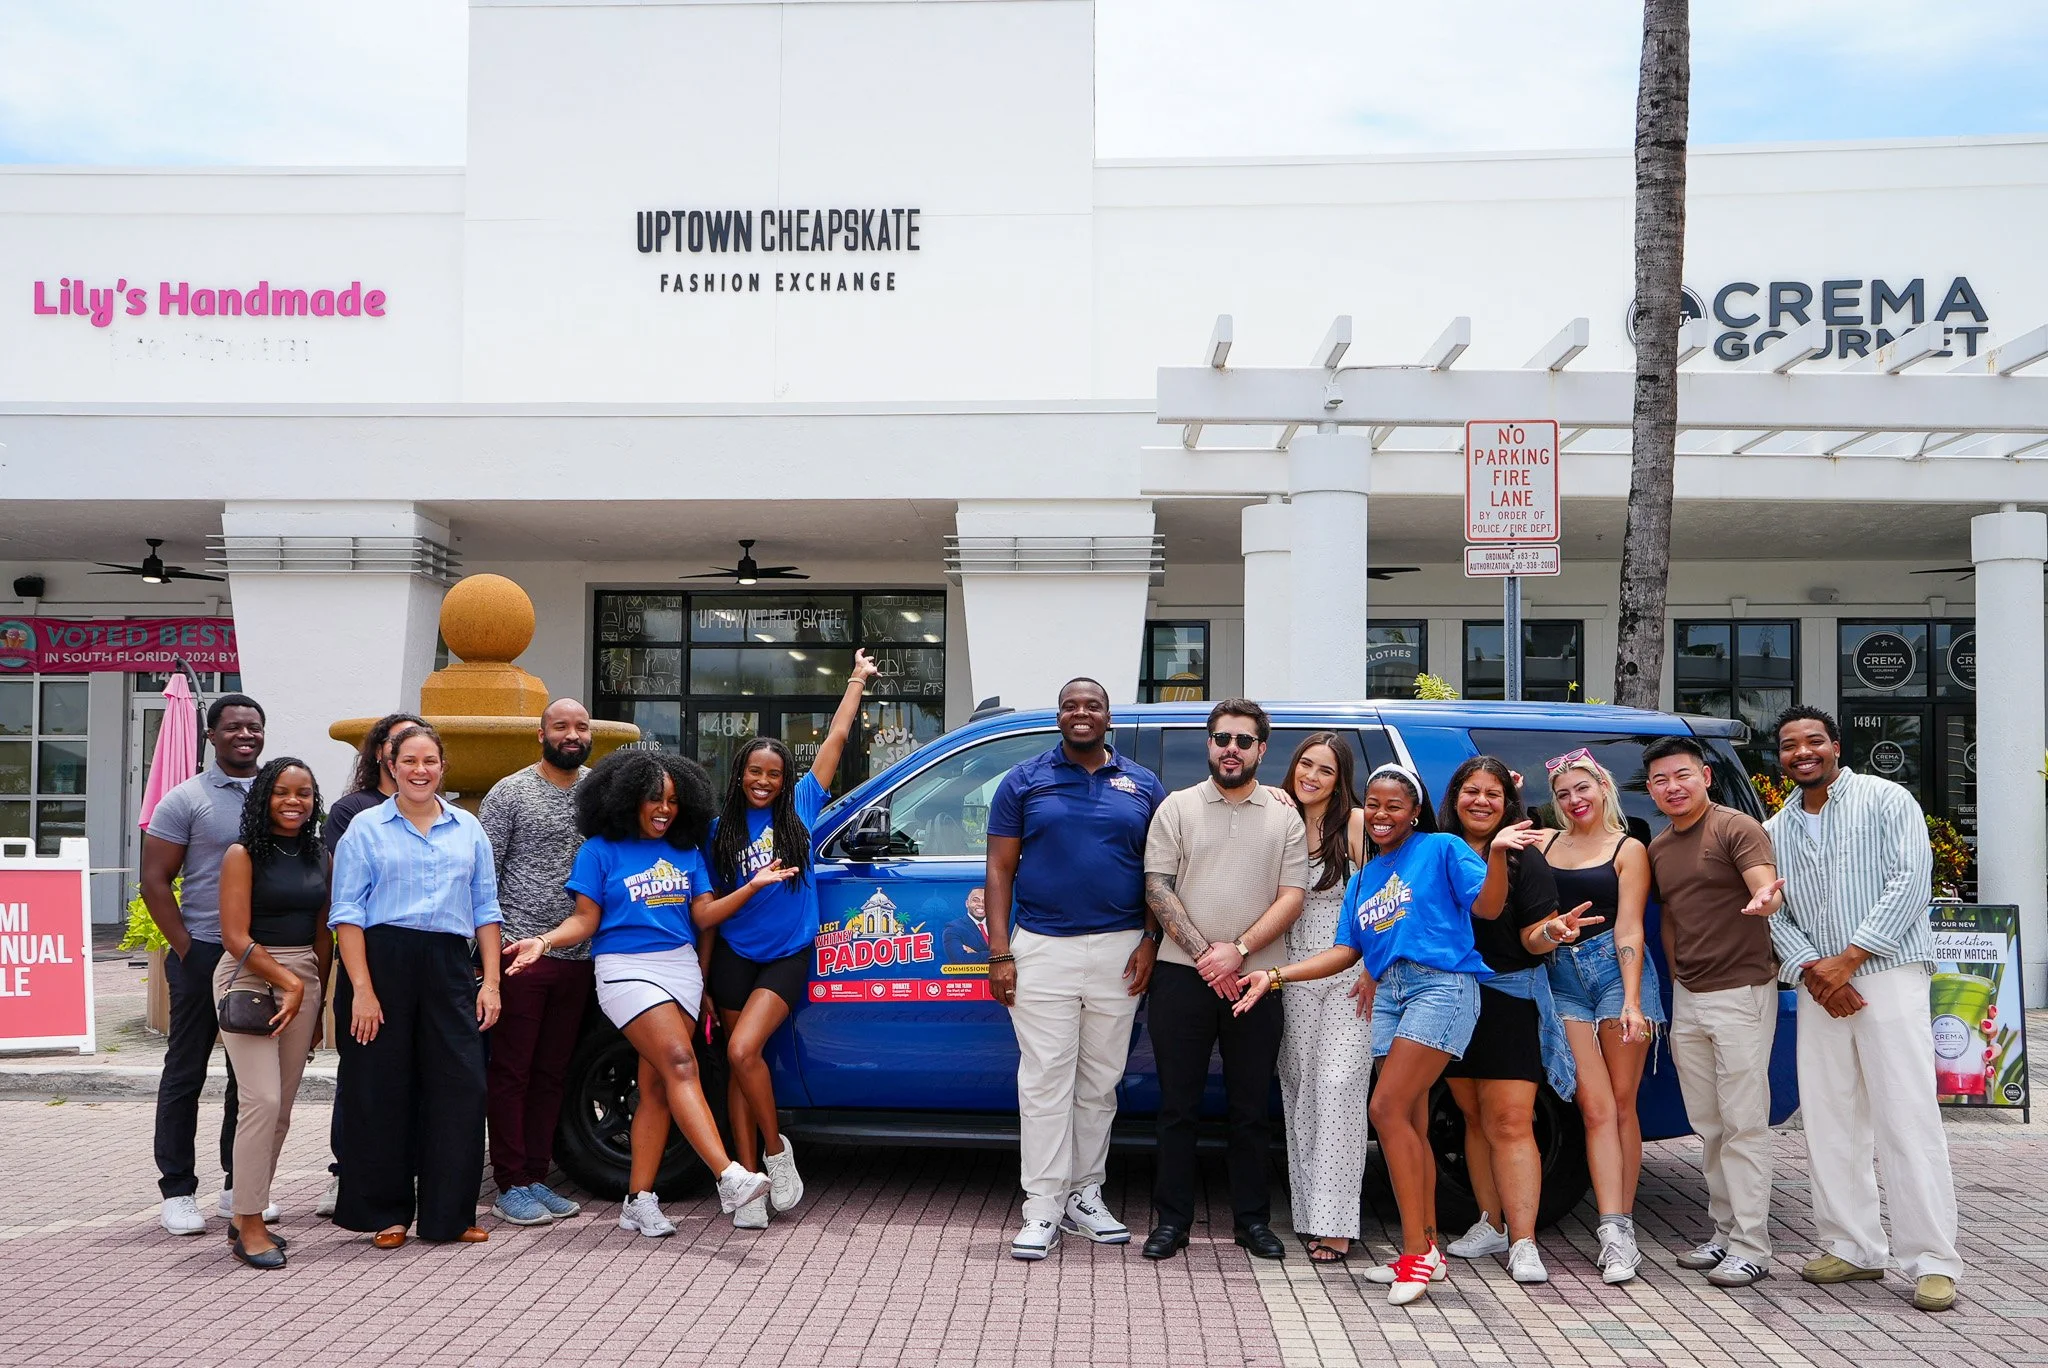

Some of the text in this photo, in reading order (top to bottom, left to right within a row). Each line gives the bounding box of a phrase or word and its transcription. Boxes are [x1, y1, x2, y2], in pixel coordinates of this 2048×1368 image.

[637, 208, 921, 253] UPTOWN CHEAPSKATE
[660, 272, 896, 292] FASHION EXCHANGE
[34, 278, 387, 327] Lily's Handmade
[1713, 277, 1989, 328] CREMA
[1498, 428, 1525, 445] NO
[1474, 449, 1550, 465] PARKING
[1493, 470, 1531, 486] FIRE
[1491, 491, 1534, 507] LANE
[1479, 511, 1545, 520] BY ORDER OF
[1472, 525, 1500, 533] POLICE
[1510, 524, 1527, 533] FIRE
[1530, 524, 1553, 533] DEPT.
[1485, 552, 1515, 561] ORDINANCE
[1470, 562, 1510, 571] AUTHORIZATION
[700, 608, 842, 629] UPTOWN CHEAPSKATE
[46, 625, 236, 648] VOTED BEST
[45, 652, 237, 664] IN SOUTH FLORIDA 2024 BY
[1863, 656, 1906, 665] CREMA
[1853, 716, 1881, 728] 14841
[637, 741, 647, 751] TO
[649, 741, 662, 751] US:
[629, 876, 690, 903] PADOTE
[1359, 888, 1412, 931] PADOTE
[0, 903, 29, 933] MI
[818, 921, 840, 933] LECT
[815, 930, 853, 947] WHITNEY
[1955, 934, 1994, 947] edition
[1, 934, 74, 965] NUAL
[817, 932, 934, 976] PADOTE
[1936, 948, 1998, 960] BERRY MATCHA
[0, 967, 31, 997] LE
[1934, 1033, 1964, 1041] CREMA
